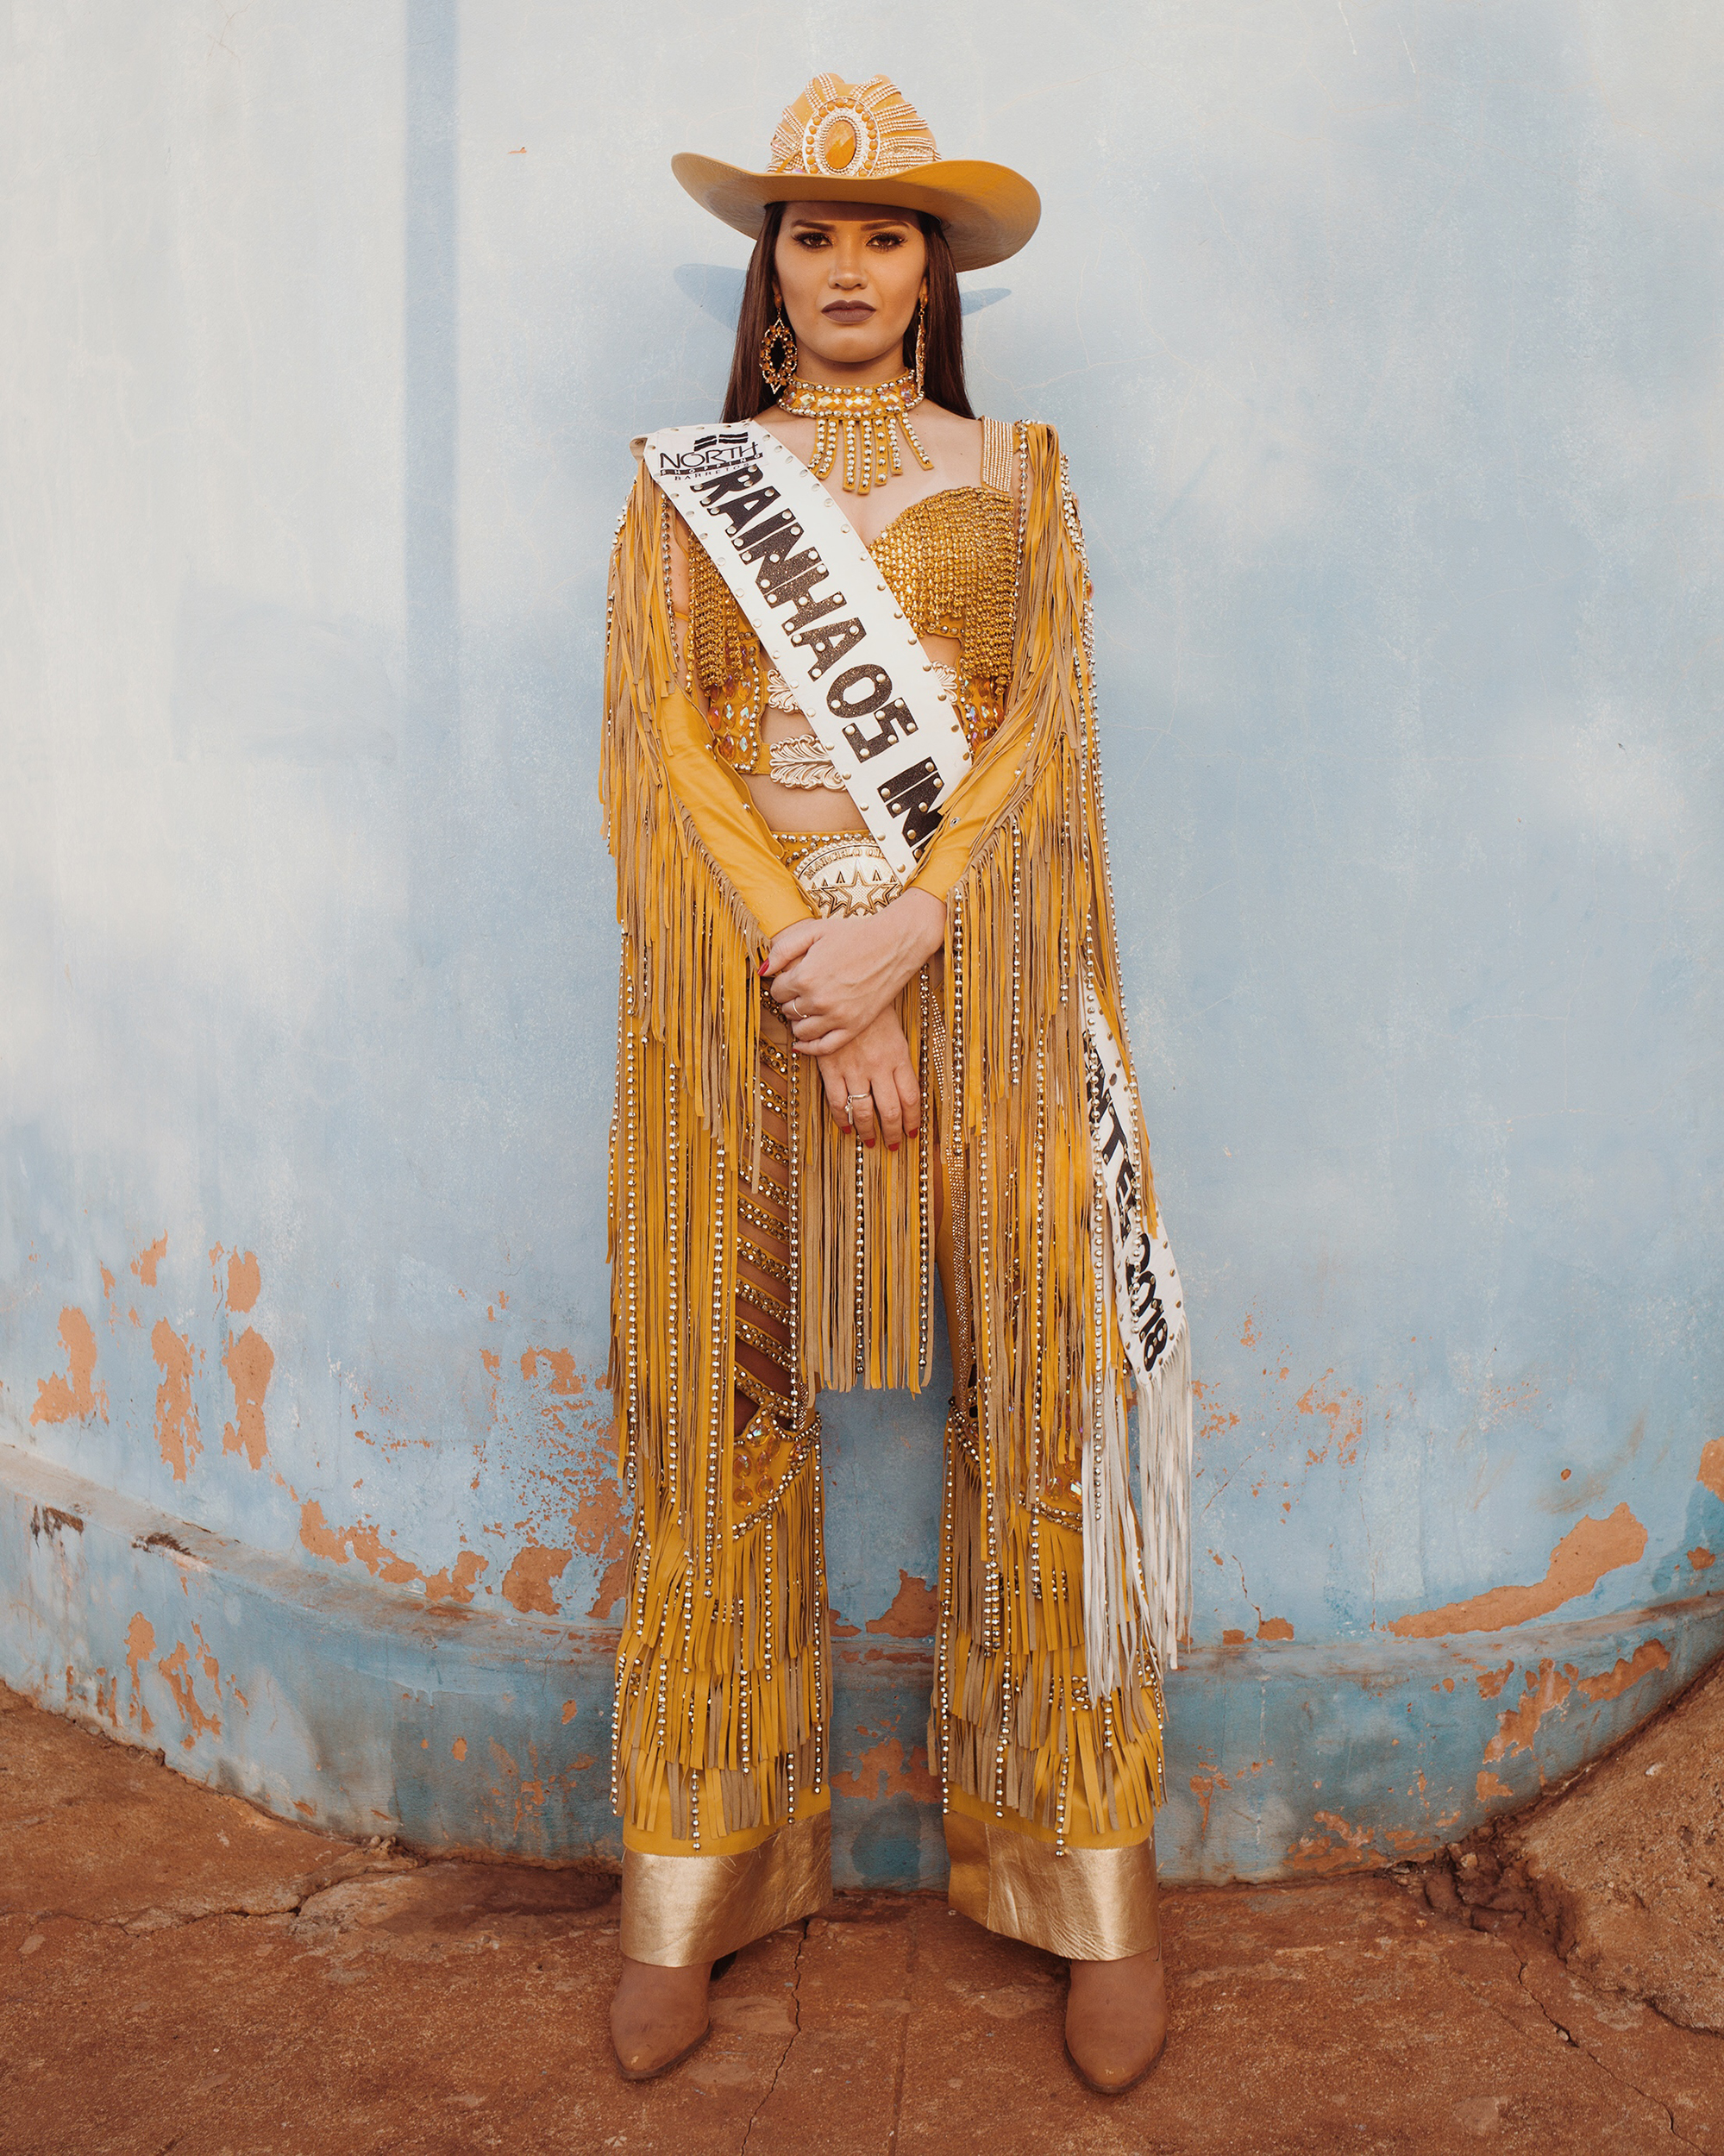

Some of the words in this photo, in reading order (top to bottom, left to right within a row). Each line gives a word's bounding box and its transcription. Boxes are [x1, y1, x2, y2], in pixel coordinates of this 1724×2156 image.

[660, 442, 758, 468] NORTH
[661, 454, 762, 475] SHOPPING
[690, 464, 868, 681] RAINHA
[877, 756, 944, 863] IN
[1125, 1233, 1168, 1371] 2018
